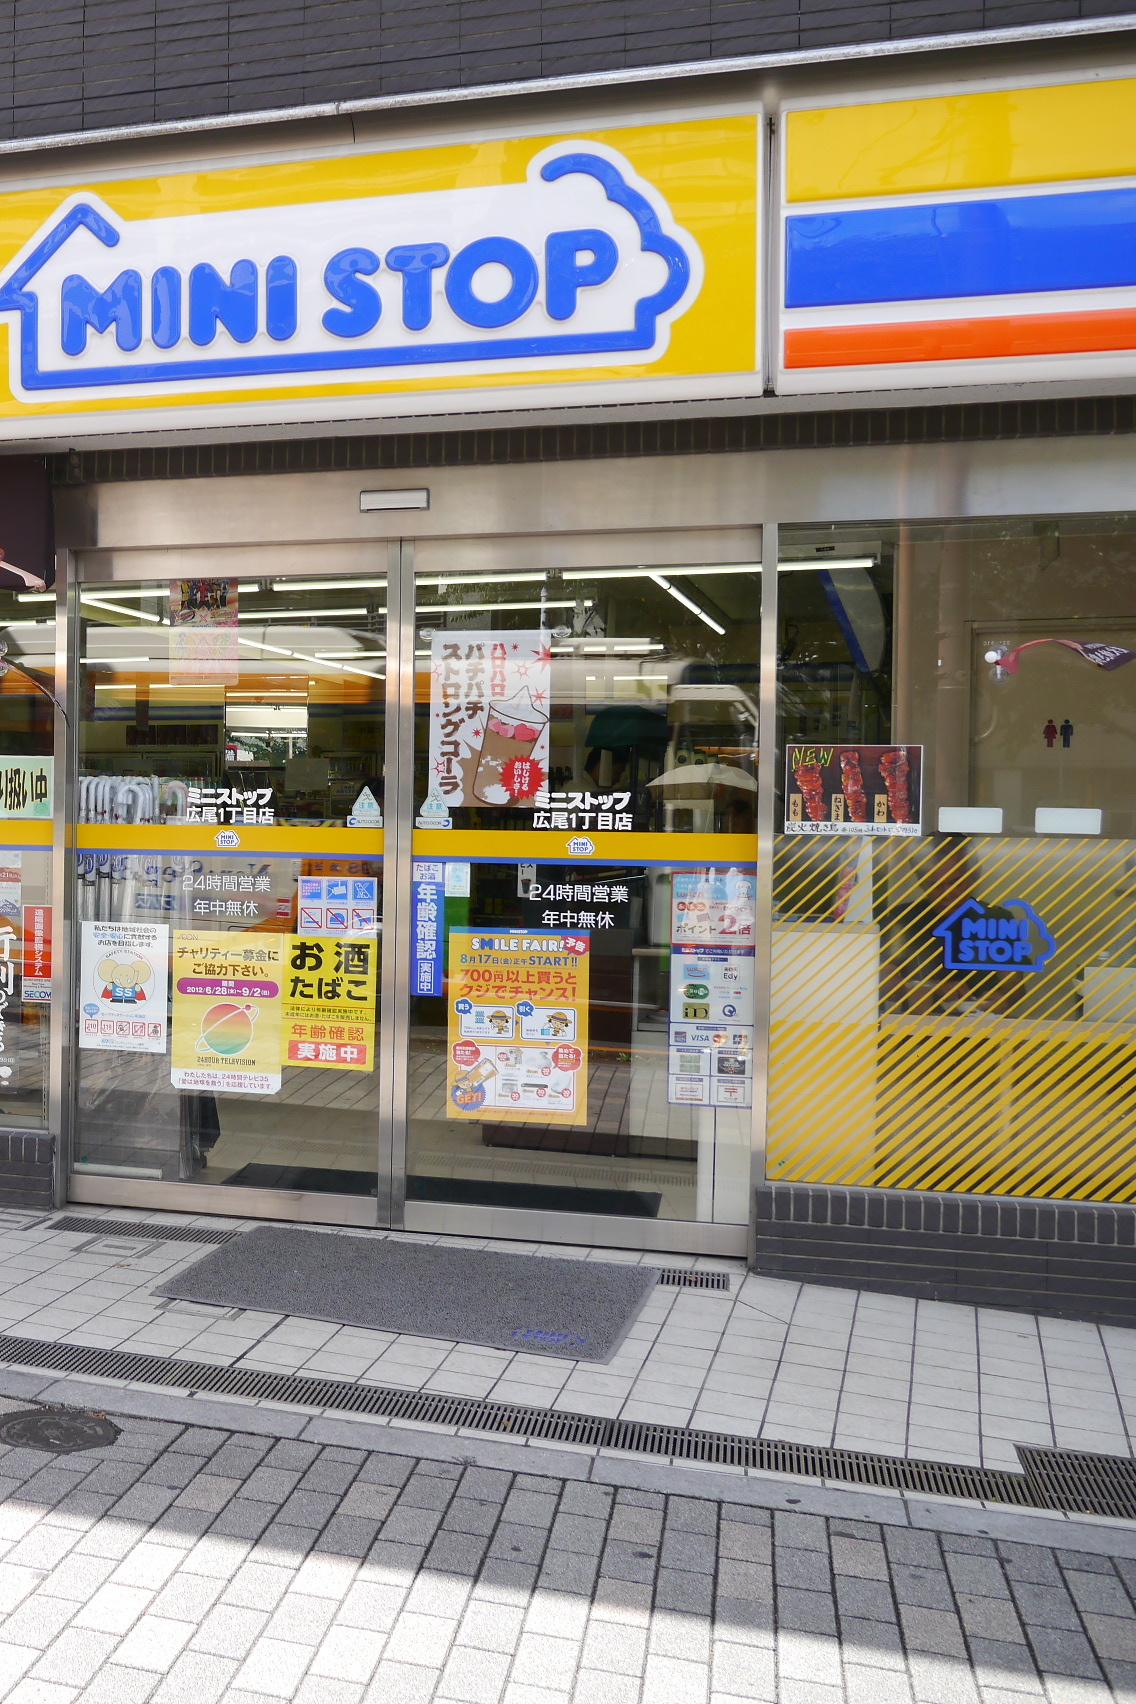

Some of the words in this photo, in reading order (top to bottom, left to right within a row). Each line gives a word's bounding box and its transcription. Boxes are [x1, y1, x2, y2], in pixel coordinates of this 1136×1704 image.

[61, 254, 298, 357] MINI
[322, 228, 619, 338] STOP
[490, 643, 507, 697] ハロハロ
[464, 642, 485, 719] パチパチ
[438, 643, 465, 795] ストロングコーラ
[791, 747, 833, 772] NEW
[187, 787, 273, 805] ミニストップ
[534, 791, 631, 810] ミニストップ
[186, 807, 275, 824] 広尾1丁目店
[532, 812, 633, 831] 広尾1丁目店
[416, 863, 439, 872] たばこ
[420, 872, 436, 881] お酒
[183, 874, 271, 893] 24時間営業
[528, 883, 629, 904] 24時間営業
[193, 899, 259, 917] 年中無休
[416, 883, 438, 960] 年齢確認
[541, 910, 615, 929] 年中無休
[961, 918, 1028, 940] MINI
[471, 936, 519, 951] SMILE
[522, 938, 565, 952] FAIR!
[959, 941, 1032, 961] STOP
[177, 946, 280, 962] チャリティー募金に
[290, 941, 371, 975] お酒
[192, 962, 269, 978] ご協力下さい。
[723, 972, 738, 981] Edy
[115, 987, 133, 997] SS
[289, 976, 368, 1002] たばこ
[459, 983, 576, 1002] クジでチャンス!
[291, 1022, 365, 1042] 年齢確認
[690, 1034, 710, 1042] VISA
[221, 1058, 256, 1066] TELEVISION
[297, 1043, 359, 1062] 実施中
